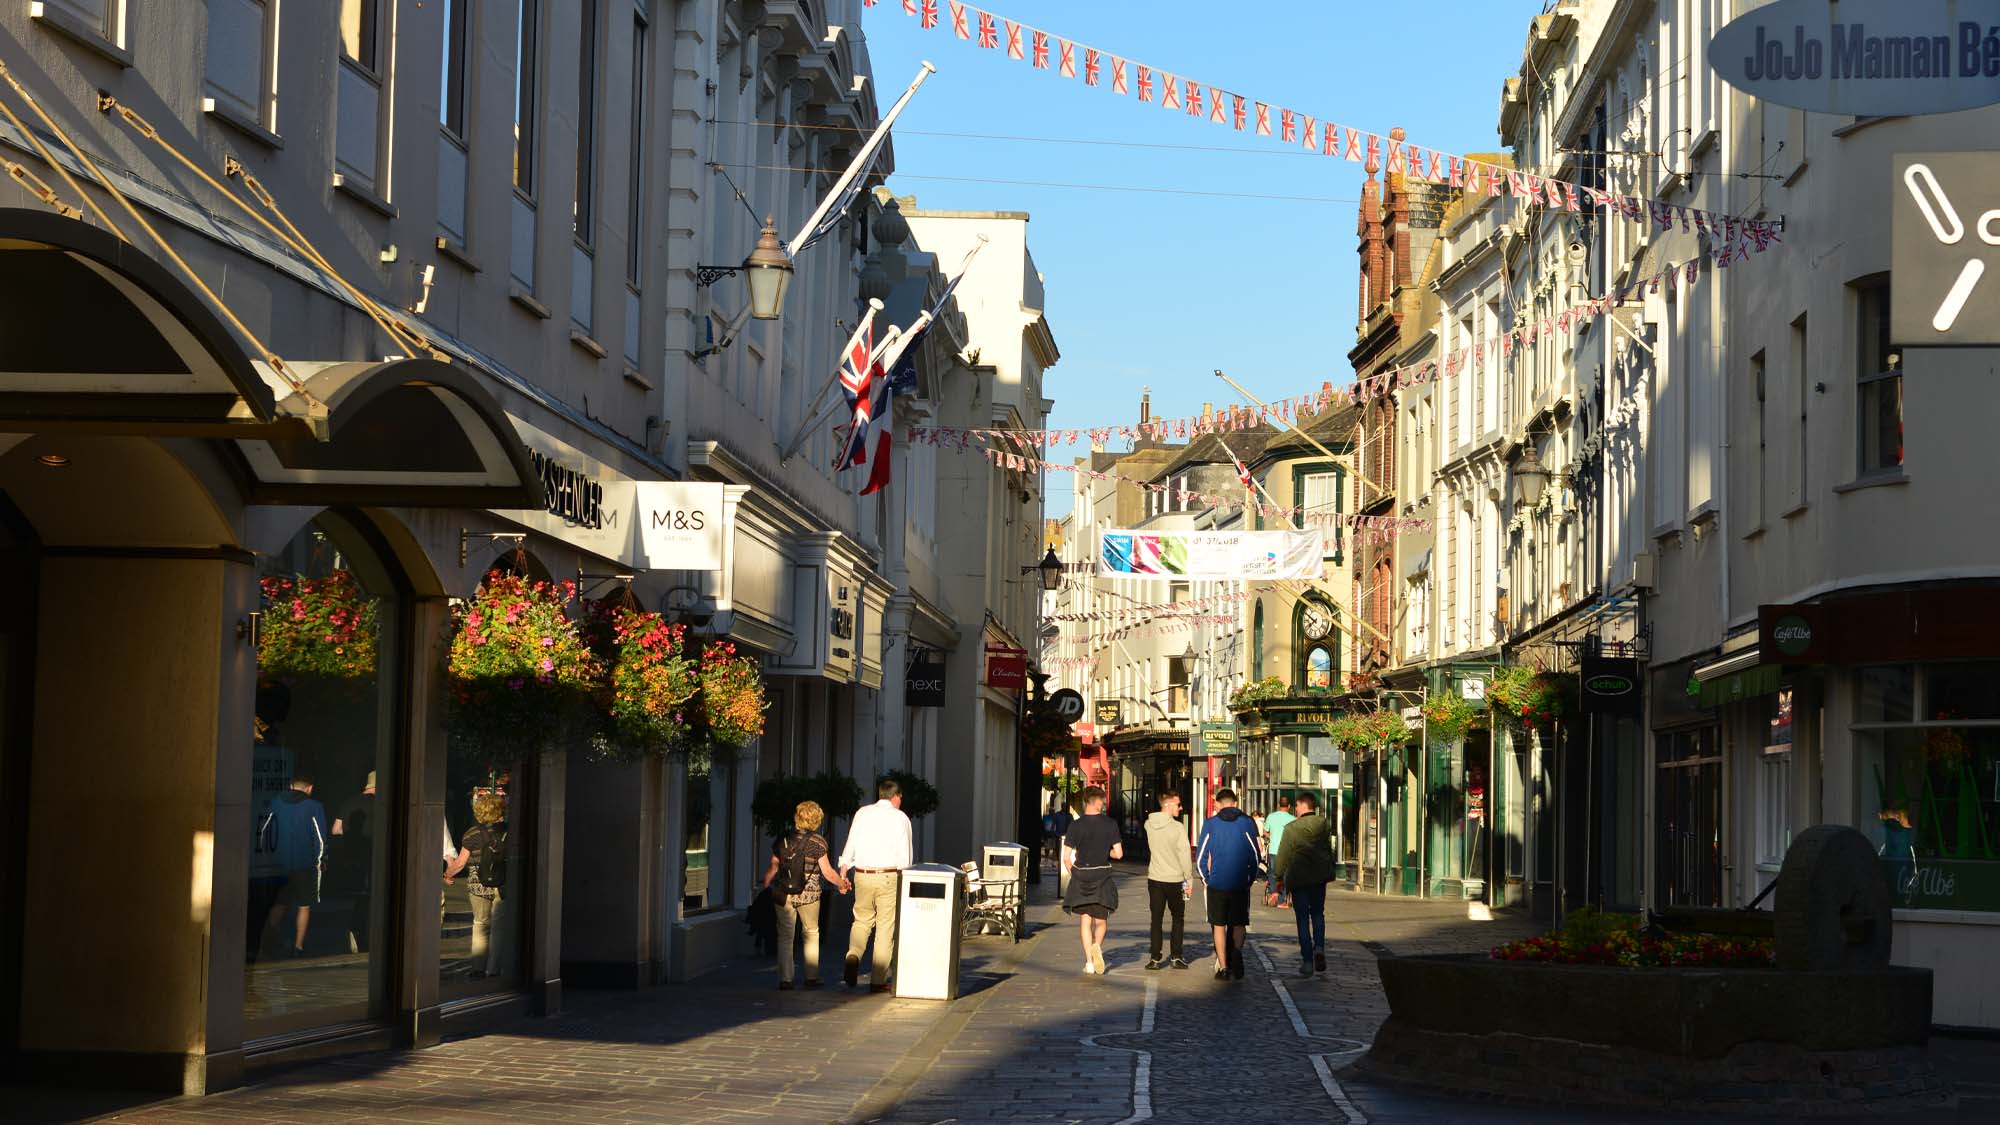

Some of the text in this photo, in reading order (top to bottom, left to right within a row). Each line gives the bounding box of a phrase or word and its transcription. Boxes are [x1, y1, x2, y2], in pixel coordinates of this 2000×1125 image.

[1744, 25, 1823, 81] JoJo
[1830, 23, 1950, 80] Maman
[548, 458, 603, 530] SPENCER
[652, 510, 704, 531] M&S
[904, 679, 942, 692] next
[1057, 696, 1081, 714] JD
[1296, 712, 1332, 723] RIVOLI
